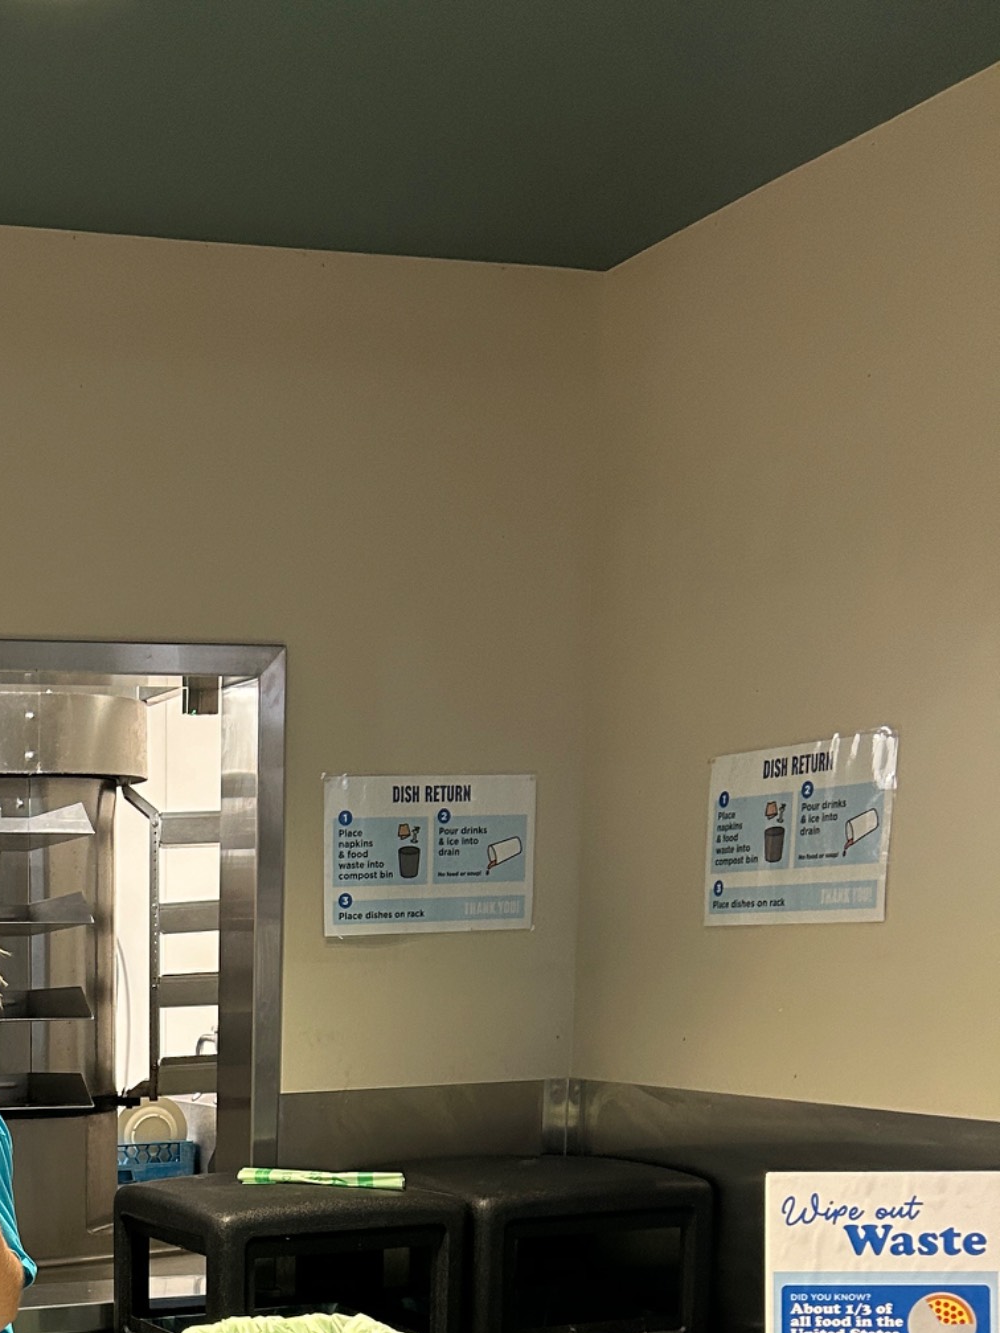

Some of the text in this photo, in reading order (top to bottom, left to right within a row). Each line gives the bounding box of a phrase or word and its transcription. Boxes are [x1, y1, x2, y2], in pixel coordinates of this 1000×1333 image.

[763, 751, 834, 779] DISH RETURN
[392, 785, 471, 803] DISH RETURN
[801, 799, 847, 812] Pour drinks
[821, 812, 838, 822] into
[338, 829, 363, 838] Place
[439, 826, 488, 835] Pour drinks
[338, 840, 373, 849] napkins
[438, 837, 479, 846] & ice into
[338, 850, 369, 859] & food
[438, 848, 460, 857] drain
[745, 855, 759, 864] bin
[338, 860, 385, 870] waste into
[338, 871, 393, 881] compost bin
[464, 901, 496, 915] THANK
[712, 897, 785, 909] Place dishes on rack
[338, 911, 363, 920] Place
[365, 910, 393, 920] dishes
[406, 909, 425, 918] rack
[781, 1193, 924, 1227] Wipe out
[843, 1224, 988, 1256] Waste
[790, 1293, 872, 1301] DID YOU KNOW?
[790, 1302, 894, 1317] About 1/3 of
[790, 1315, 904, 1327] all food in the
